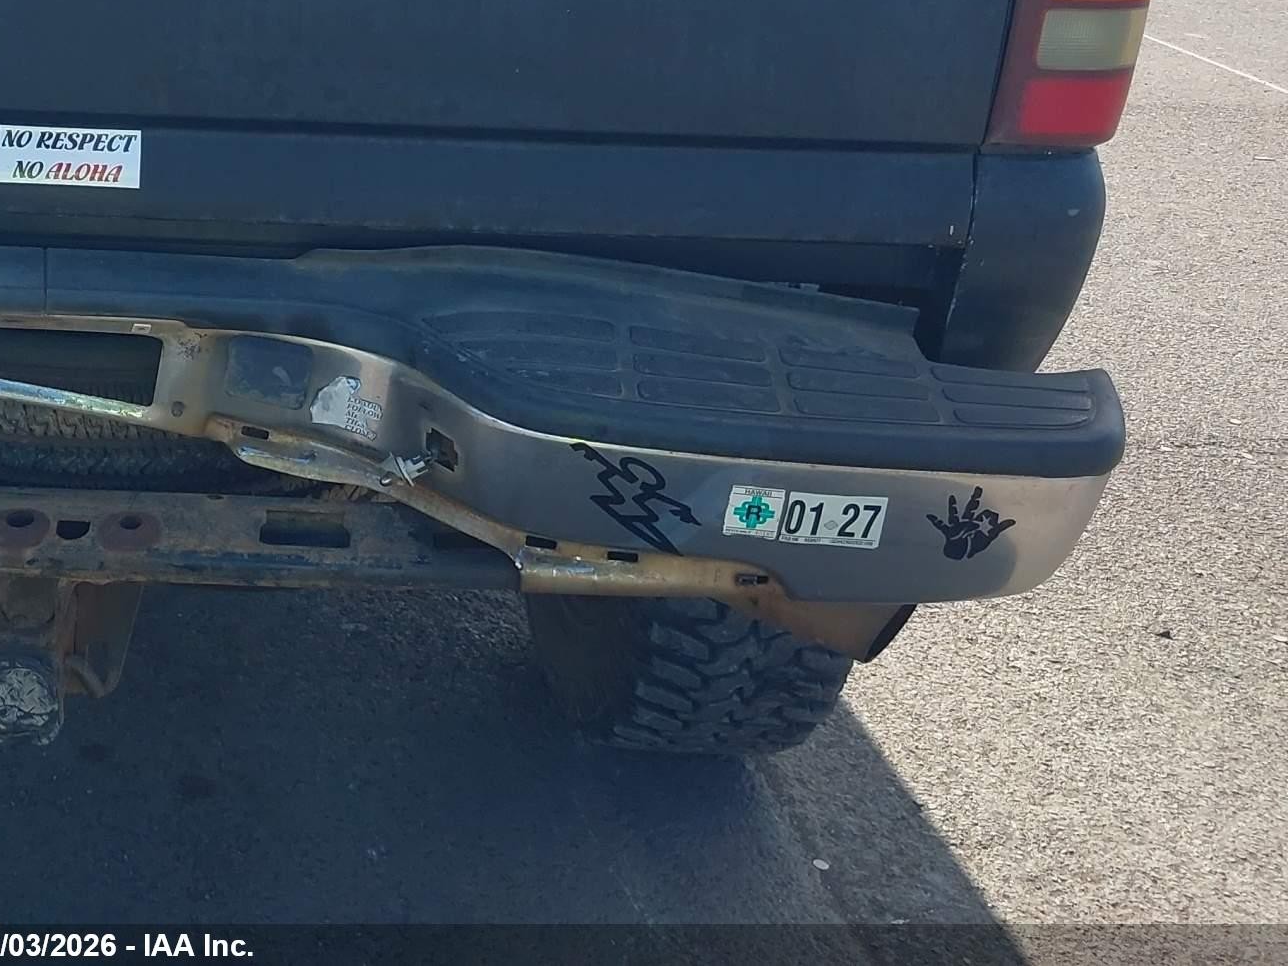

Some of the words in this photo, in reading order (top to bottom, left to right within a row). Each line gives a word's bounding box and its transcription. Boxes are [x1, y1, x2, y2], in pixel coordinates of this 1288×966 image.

[1, 129, 33, 148] NO
[36, 130, 138, 153] RESPECT
[12, 160, 44, 179] NO
[45, 162, 123, 183] ALOHA
[745, 504, 762, 521] R
[784, 499, 825, 536] 01
[837, 503, 882, 539] 27
